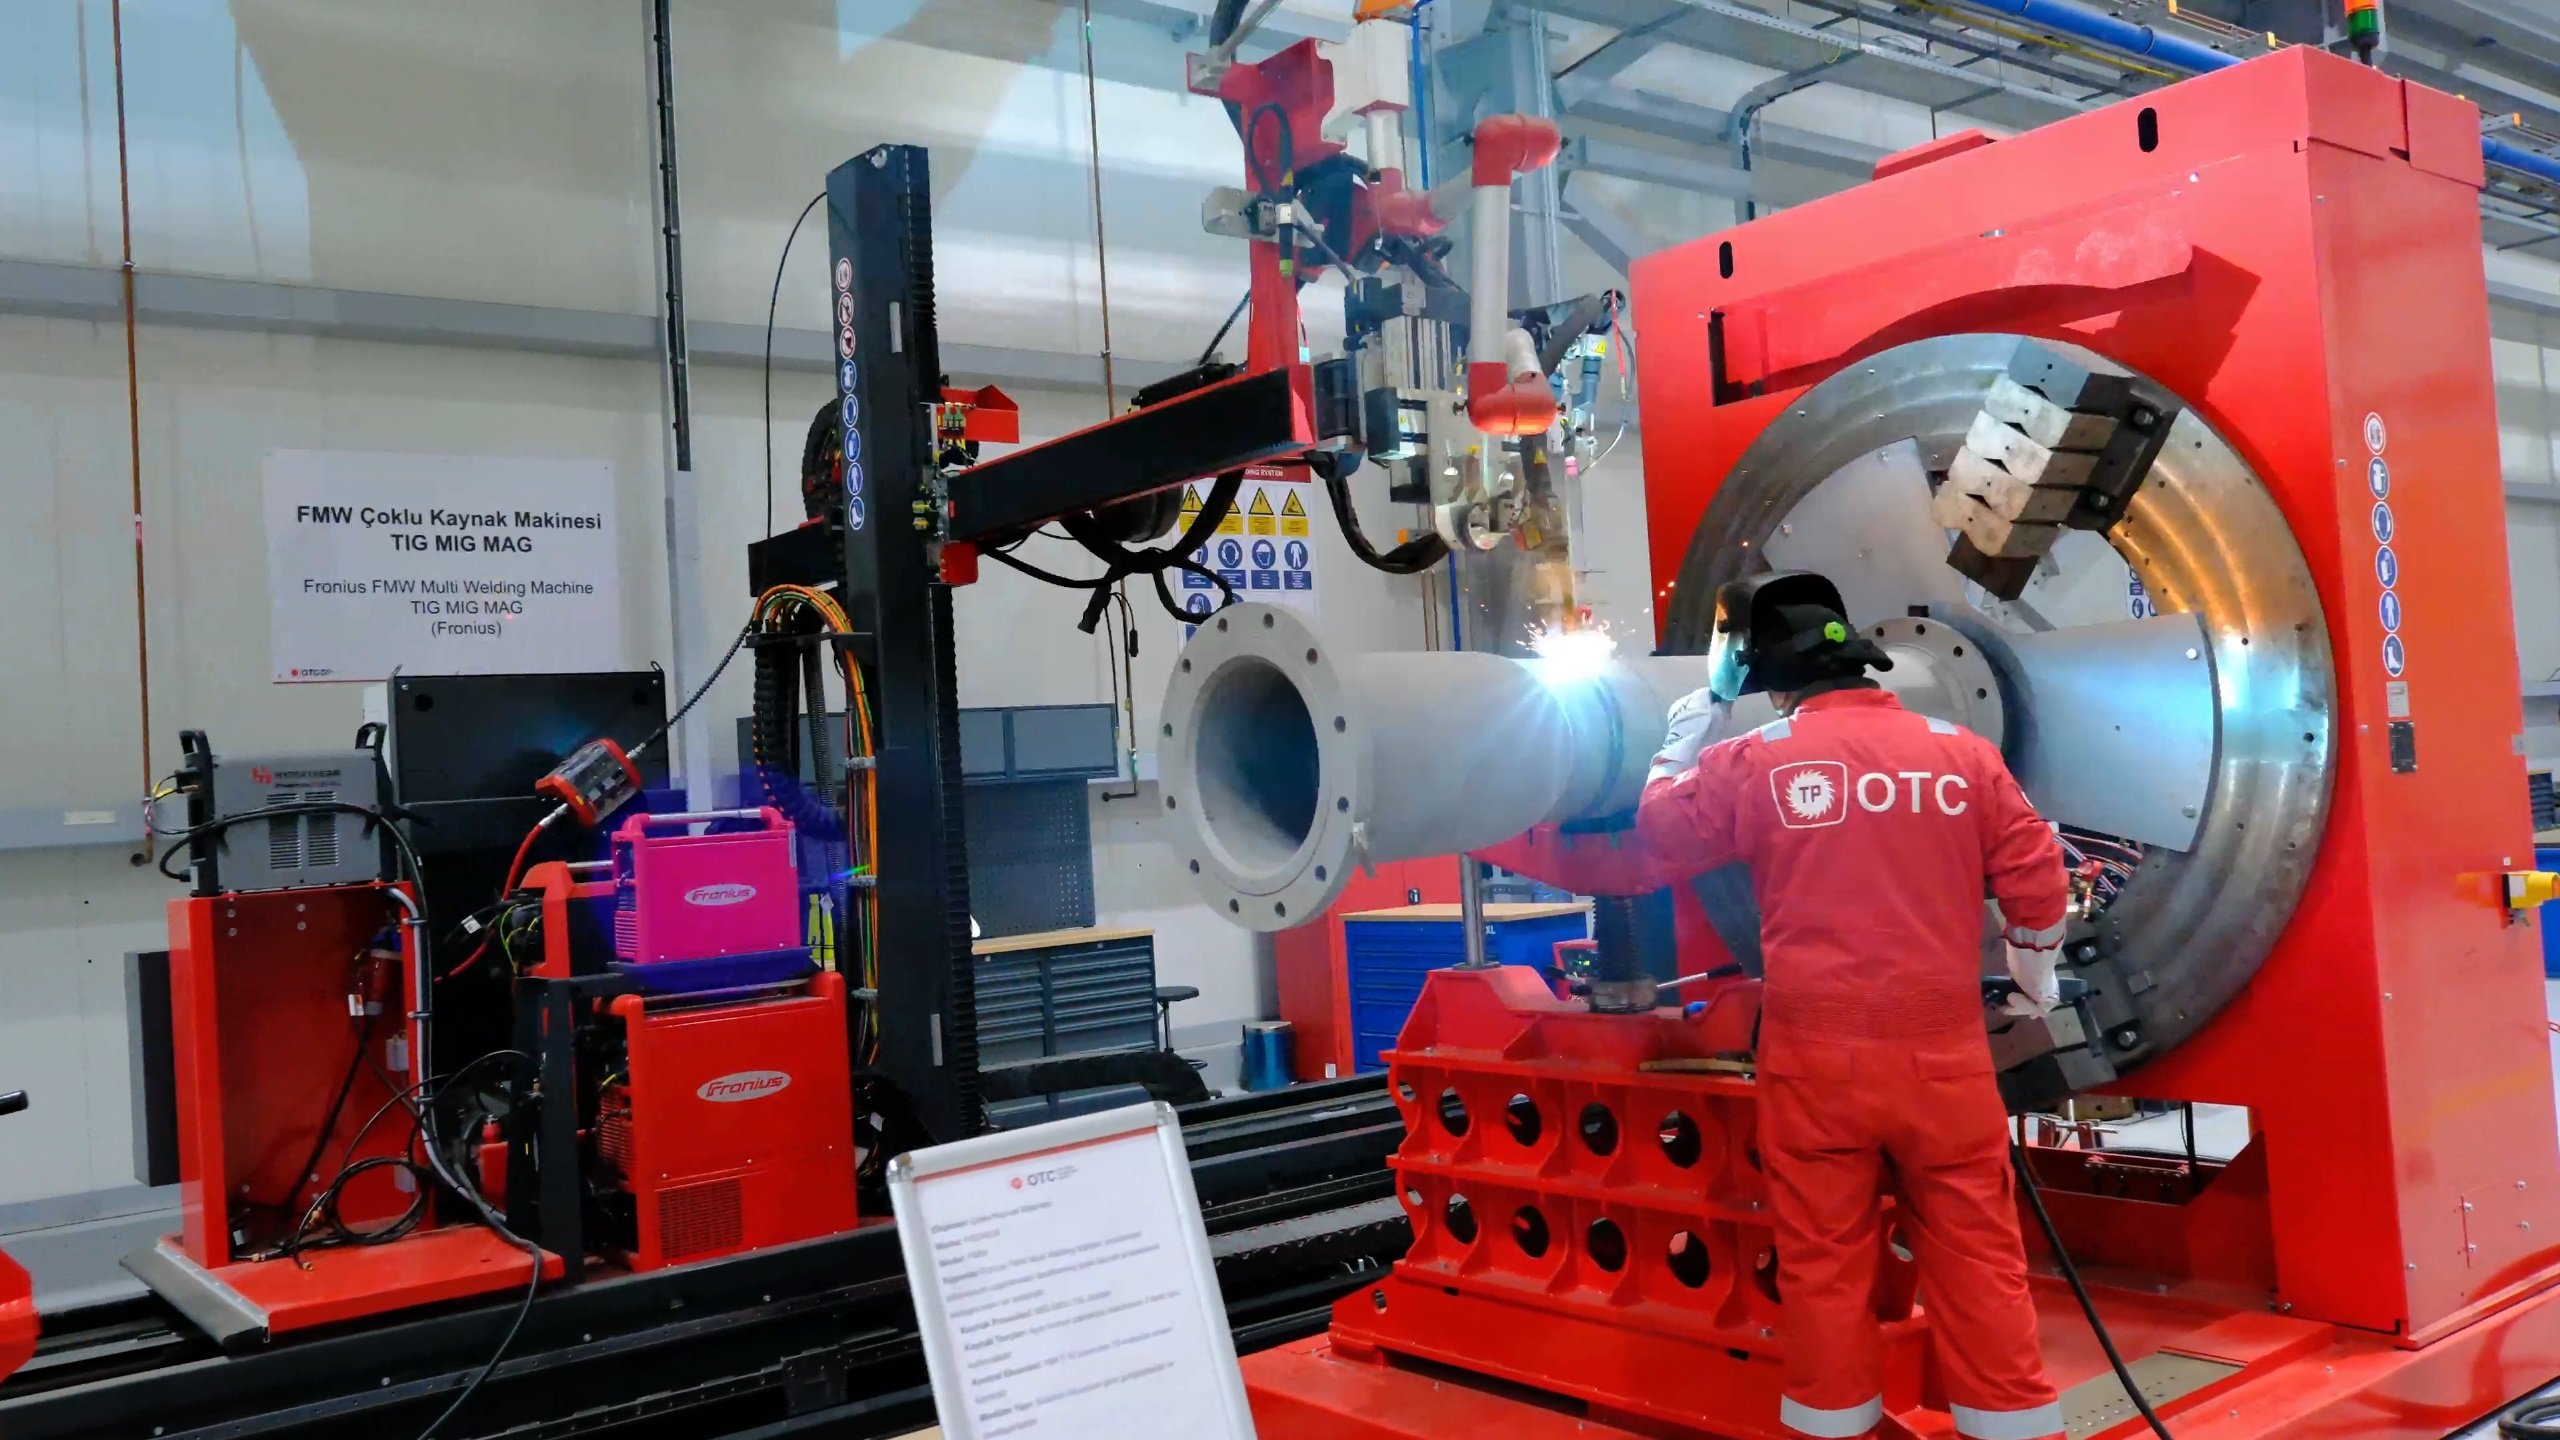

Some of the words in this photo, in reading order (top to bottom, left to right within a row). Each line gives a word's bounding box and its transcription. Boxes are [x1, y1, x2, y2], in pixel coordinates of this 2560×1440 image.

[297, 505, 353, 524] FMW
[360, 507, 423, 529] Çoklu
[430, 509, 507, 531] Kaynak
[514, 511, 602, 530] Makinesi
[390, 534, 428, 551] TIG
[435, 535, 476, 552] MIG
[483, 536, 532, 553] MAG
[303, 579, 366, 594] Fronius
[372, 580, 416, 594] FMW
[421, 580, 458, 594] Multi
[463, 580, 526, 597] Welding
[531, 580, 594, 595] Machine
[410, 600, 440, 614] TIG
[446, 600, 479, 614] MIG
[484, 600, 523, 614] MAG
[431, 621, 502, 638] (Fronius)
[1798, 784, 1822, 804] TP
[1856, 772, 1969, 816] OTC
[691, 887, 751, 901] Fronius
[705, 1076, 784, 1098] Fronius
[1027, 1169, 1057, 1187] OTC
